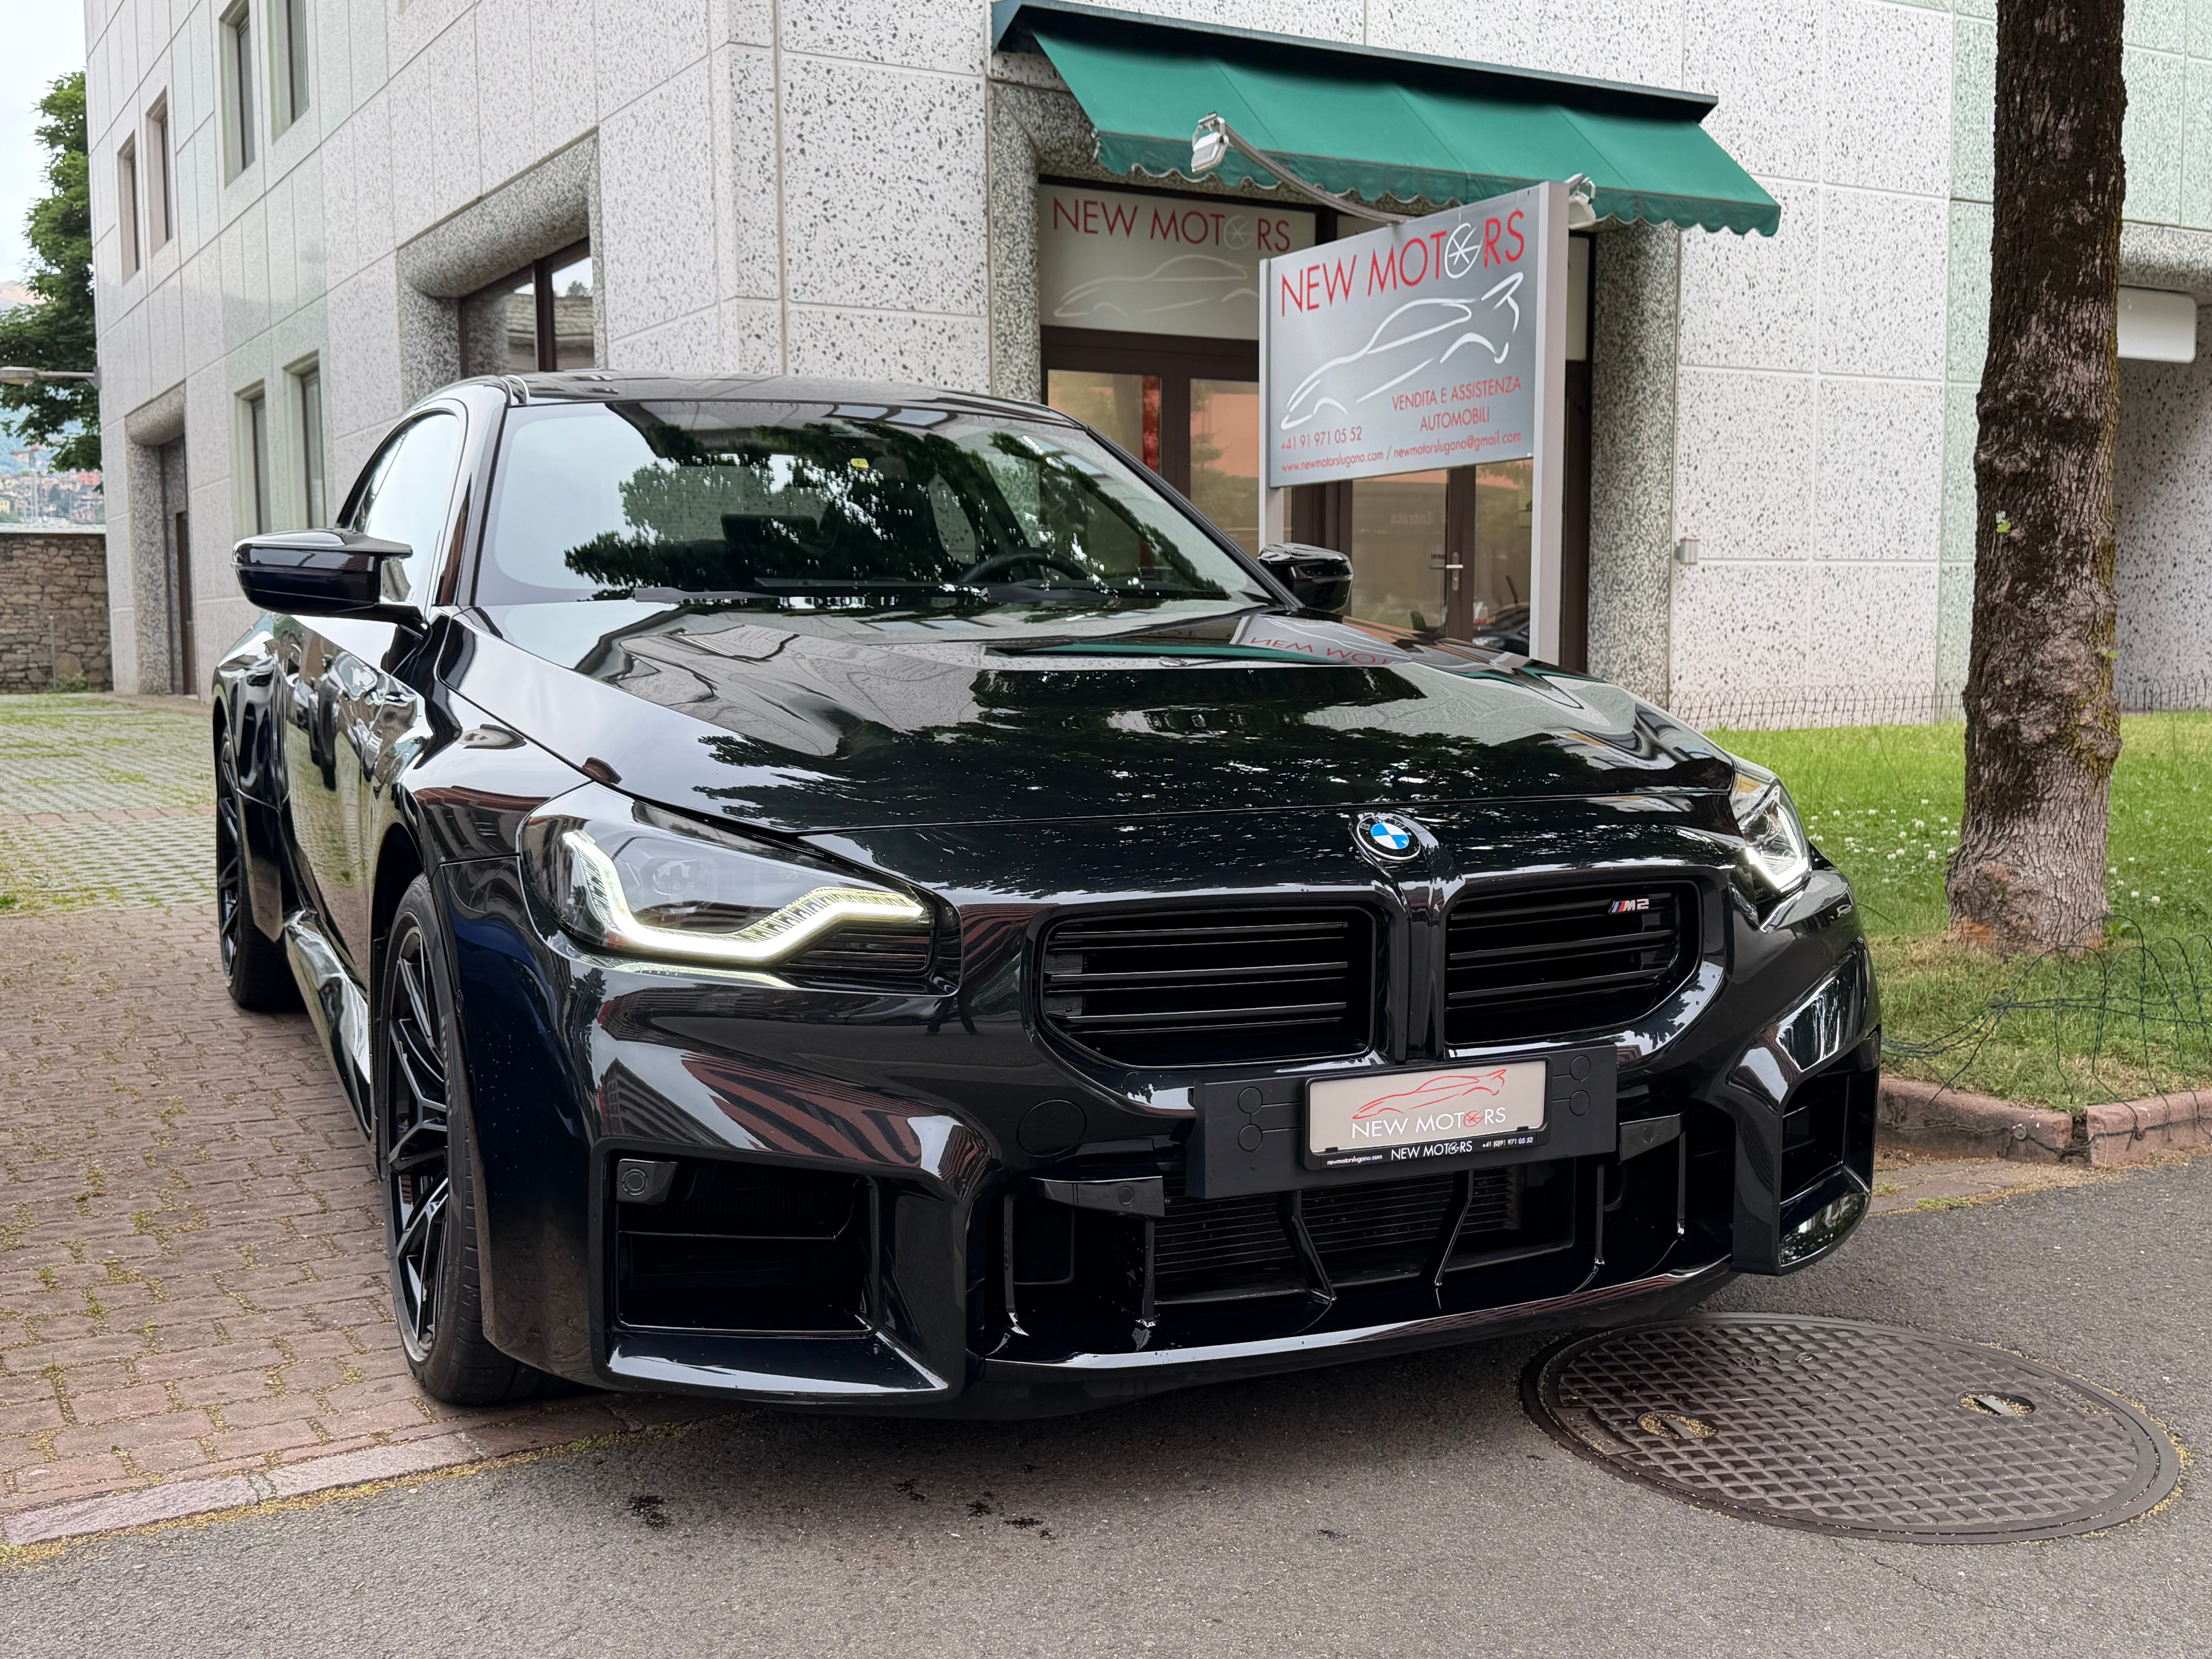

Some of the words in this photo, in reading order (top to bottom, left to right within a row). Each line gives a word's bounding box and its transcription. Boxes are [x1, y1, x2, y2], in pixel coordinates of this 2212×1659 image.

[1053, 197, 1138, 238] NEW
[1150, 207, 1290, 252] MOTORS
[1281, 254, 1357, 317] NEW
[1367, 210, 1525, 297] MOTORS
[1392, 389, 1437, 411] VENDITA
[1441, 387, 1447, 404] E
[1451, 375, 1522, 402] ASSISTENZA
[1420, 405, 1490, 432] AUTOMOBILI
[1281, 435, 1296, 450] +41
[1300, 433, 1310, 448] 91
[1314, 430, 1331, 446] 971
[1334, 427, 1347, 444] 05
[1350, 425, 1363, 442] 52
[1281, 452, 1384, 472] www.newmotorslugano.com
[1394, 430, 1522, 458] newmotorslugano@gmail.com
[1352, 1118, 1408, 1139] NEW
[1415, 1107, 1506, 1133] MOTORS
[1391, 1146, 1421, 1161] NEW
[1423, 1140, 1473, 1158] MOTORS
